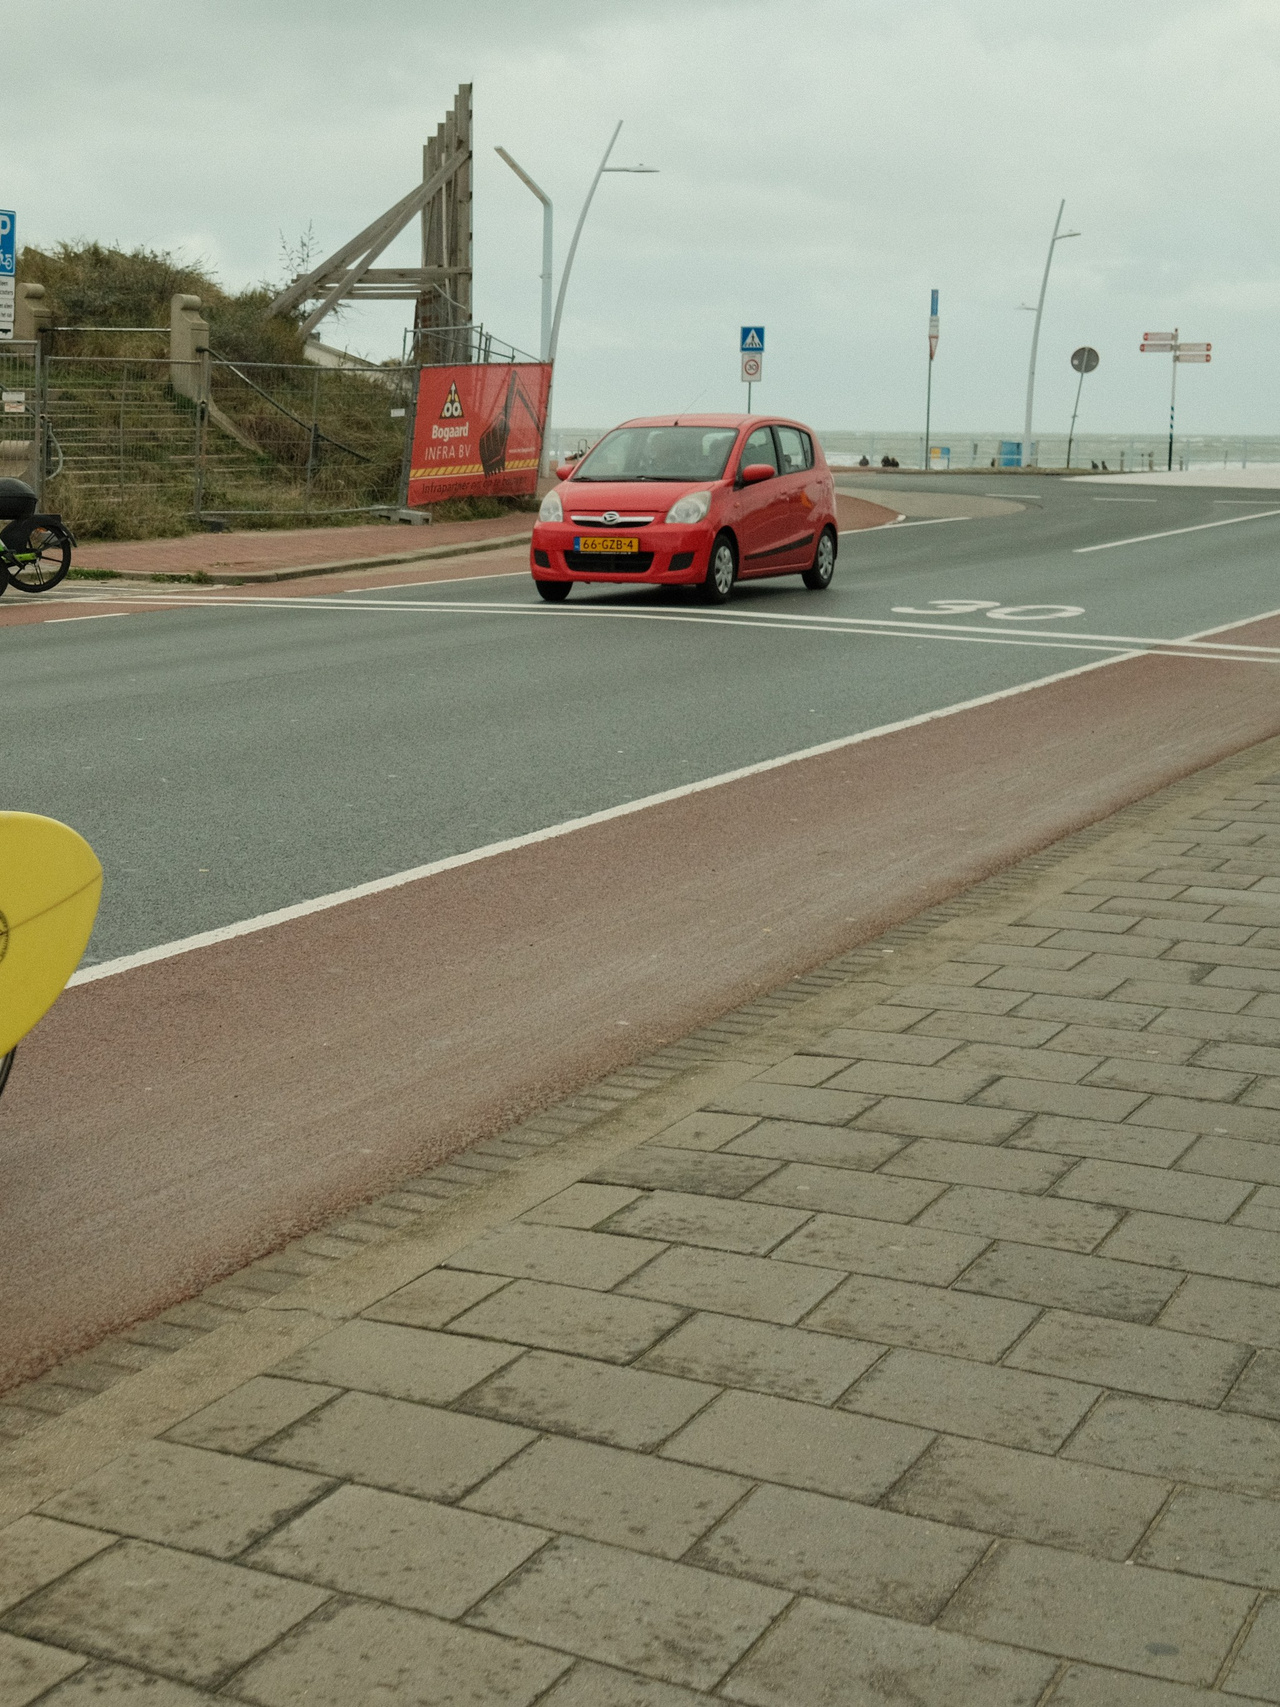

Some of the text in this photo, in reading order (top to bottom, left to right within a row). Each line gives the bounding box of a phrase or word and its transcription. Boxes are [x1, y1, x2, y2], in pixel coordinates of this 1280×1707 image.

[432, 421, 469, 442] Bogaard
[424, 444, 472, 461] INFRA BV
[422, 481, 470, 494] Infrapartner
[583, 539, 634, 549] 66-GZB-4
[890, 599, 1086, 620] 30
